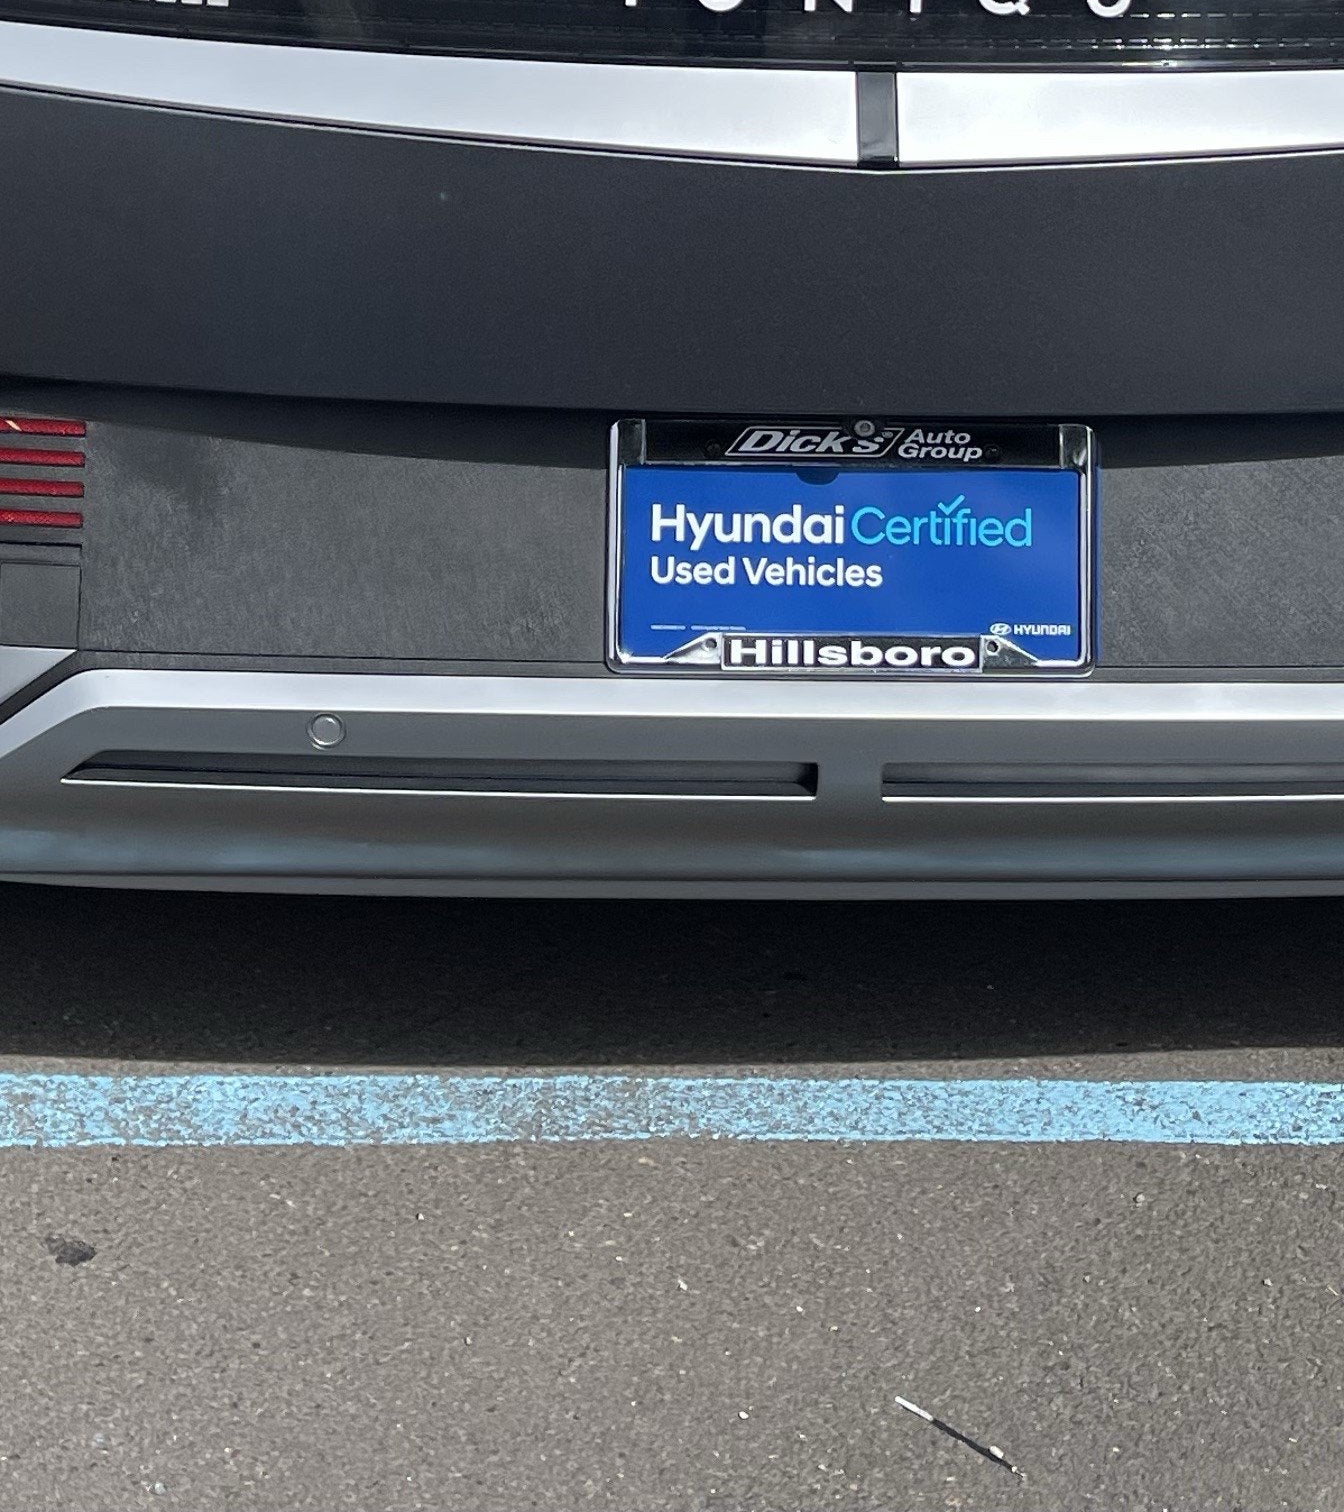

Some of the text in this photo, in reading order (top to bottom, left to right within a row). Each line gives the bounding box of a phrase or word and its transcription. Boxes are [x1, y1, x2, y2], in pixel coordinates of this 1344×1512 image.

[737, 429, 885, 453] Dicks
[905, 428, 971, 444] Auto
[897, 443, 983, 462] Group
[650, 495, 1033, 551] Hyundai Certified
[650, 556, 883, 587] Used Vehicles
[1013, 623, 1072, 636] HYUNDAI
[729, 639, 976, 667] Hillsboro
